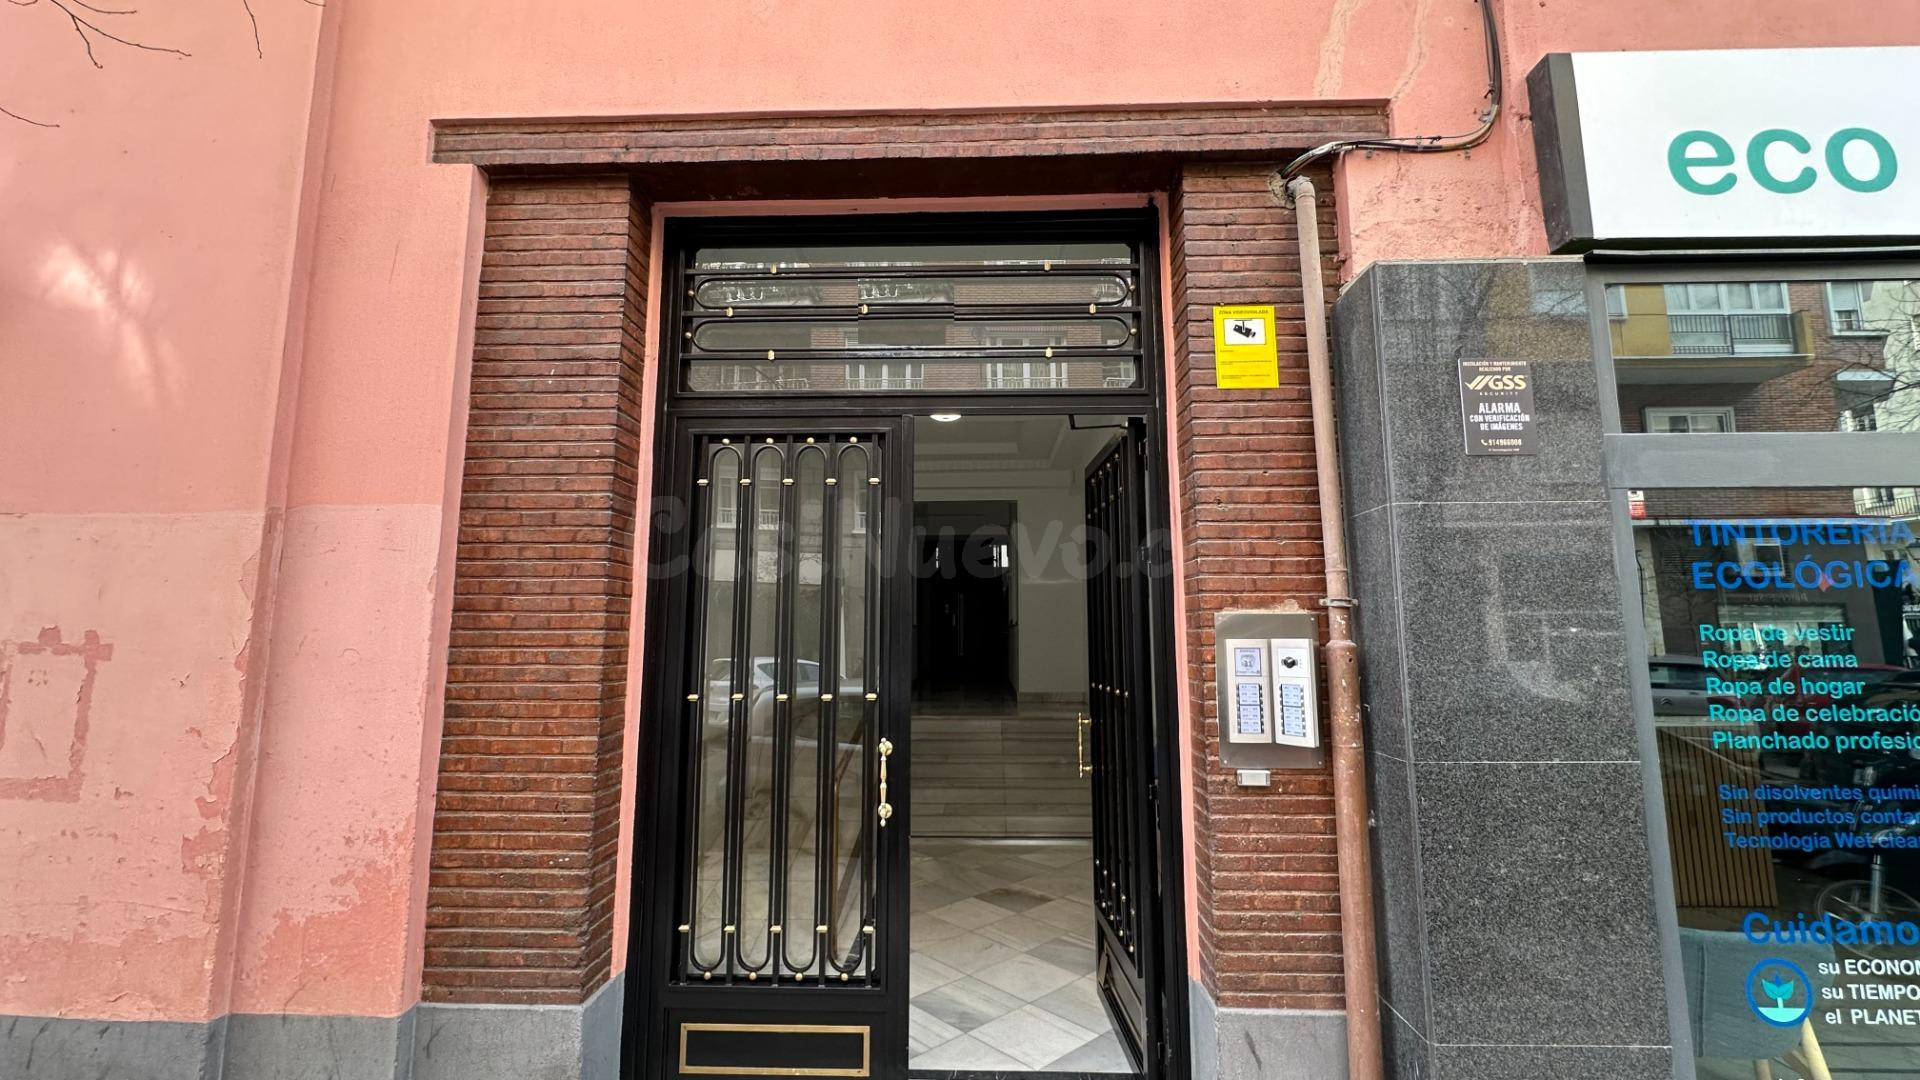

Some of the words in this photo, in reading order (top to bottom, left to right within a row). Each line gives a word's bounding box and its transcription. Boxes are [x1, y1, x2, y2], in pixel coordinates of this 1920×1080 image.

[1668, 128, 1898, 195] eco
[1488, 374, 1527, 390] GSS
[1469, 414, 1484, 422] CON
[1484, 413, 1530, 422] VERIFICACIÓN
[1478, 402, 1521, 414] ALARMA
[1480, 423, 1490, 431] DE
[1490, 421, 1524, 431] IMÁGENES
[1691, 554, 1919, 590] ECOLÓGICA
[1699, 624, 1757, 646] Ropa
[1760, 624, 1789, 641] de
[1794, 624, 1855, 641] vestir
[1702, 650, 1761, 672] Ropa
[1764, 650, 1793, 668] de
[1797, 653, 1858, 668] cama
[1705, 677, 1763, 699] Ropa
[1767, 677, 1795, 695] de
[1801, 677, 1866, 699] hogar
[1709, 704, 1767, 726] Ropa
[1771, 703, 1799, 722] de
[1712, 731, 1830, 750] Planchado
[1719, 784, 1749, 801] Sin
[1754, 784, 1864, 801] disolventes
[1722, 808, 1752, 825] Sin
[1757, 808, 1857, 827] productos
[1724, 832, 1831, 853] Tecnología
[1834, 832, 1874, 848] Wet
[1878, 833, 1920, 849] clea
[1742, 911, 1920, 946] Cuidamo
[1818, 962, 1841, 975] su
[1821, 986, 1844, 1000] su
[1846, 984, 1920, 1001] TIEMPO
[1825, 1009, 1842, 1025] el
